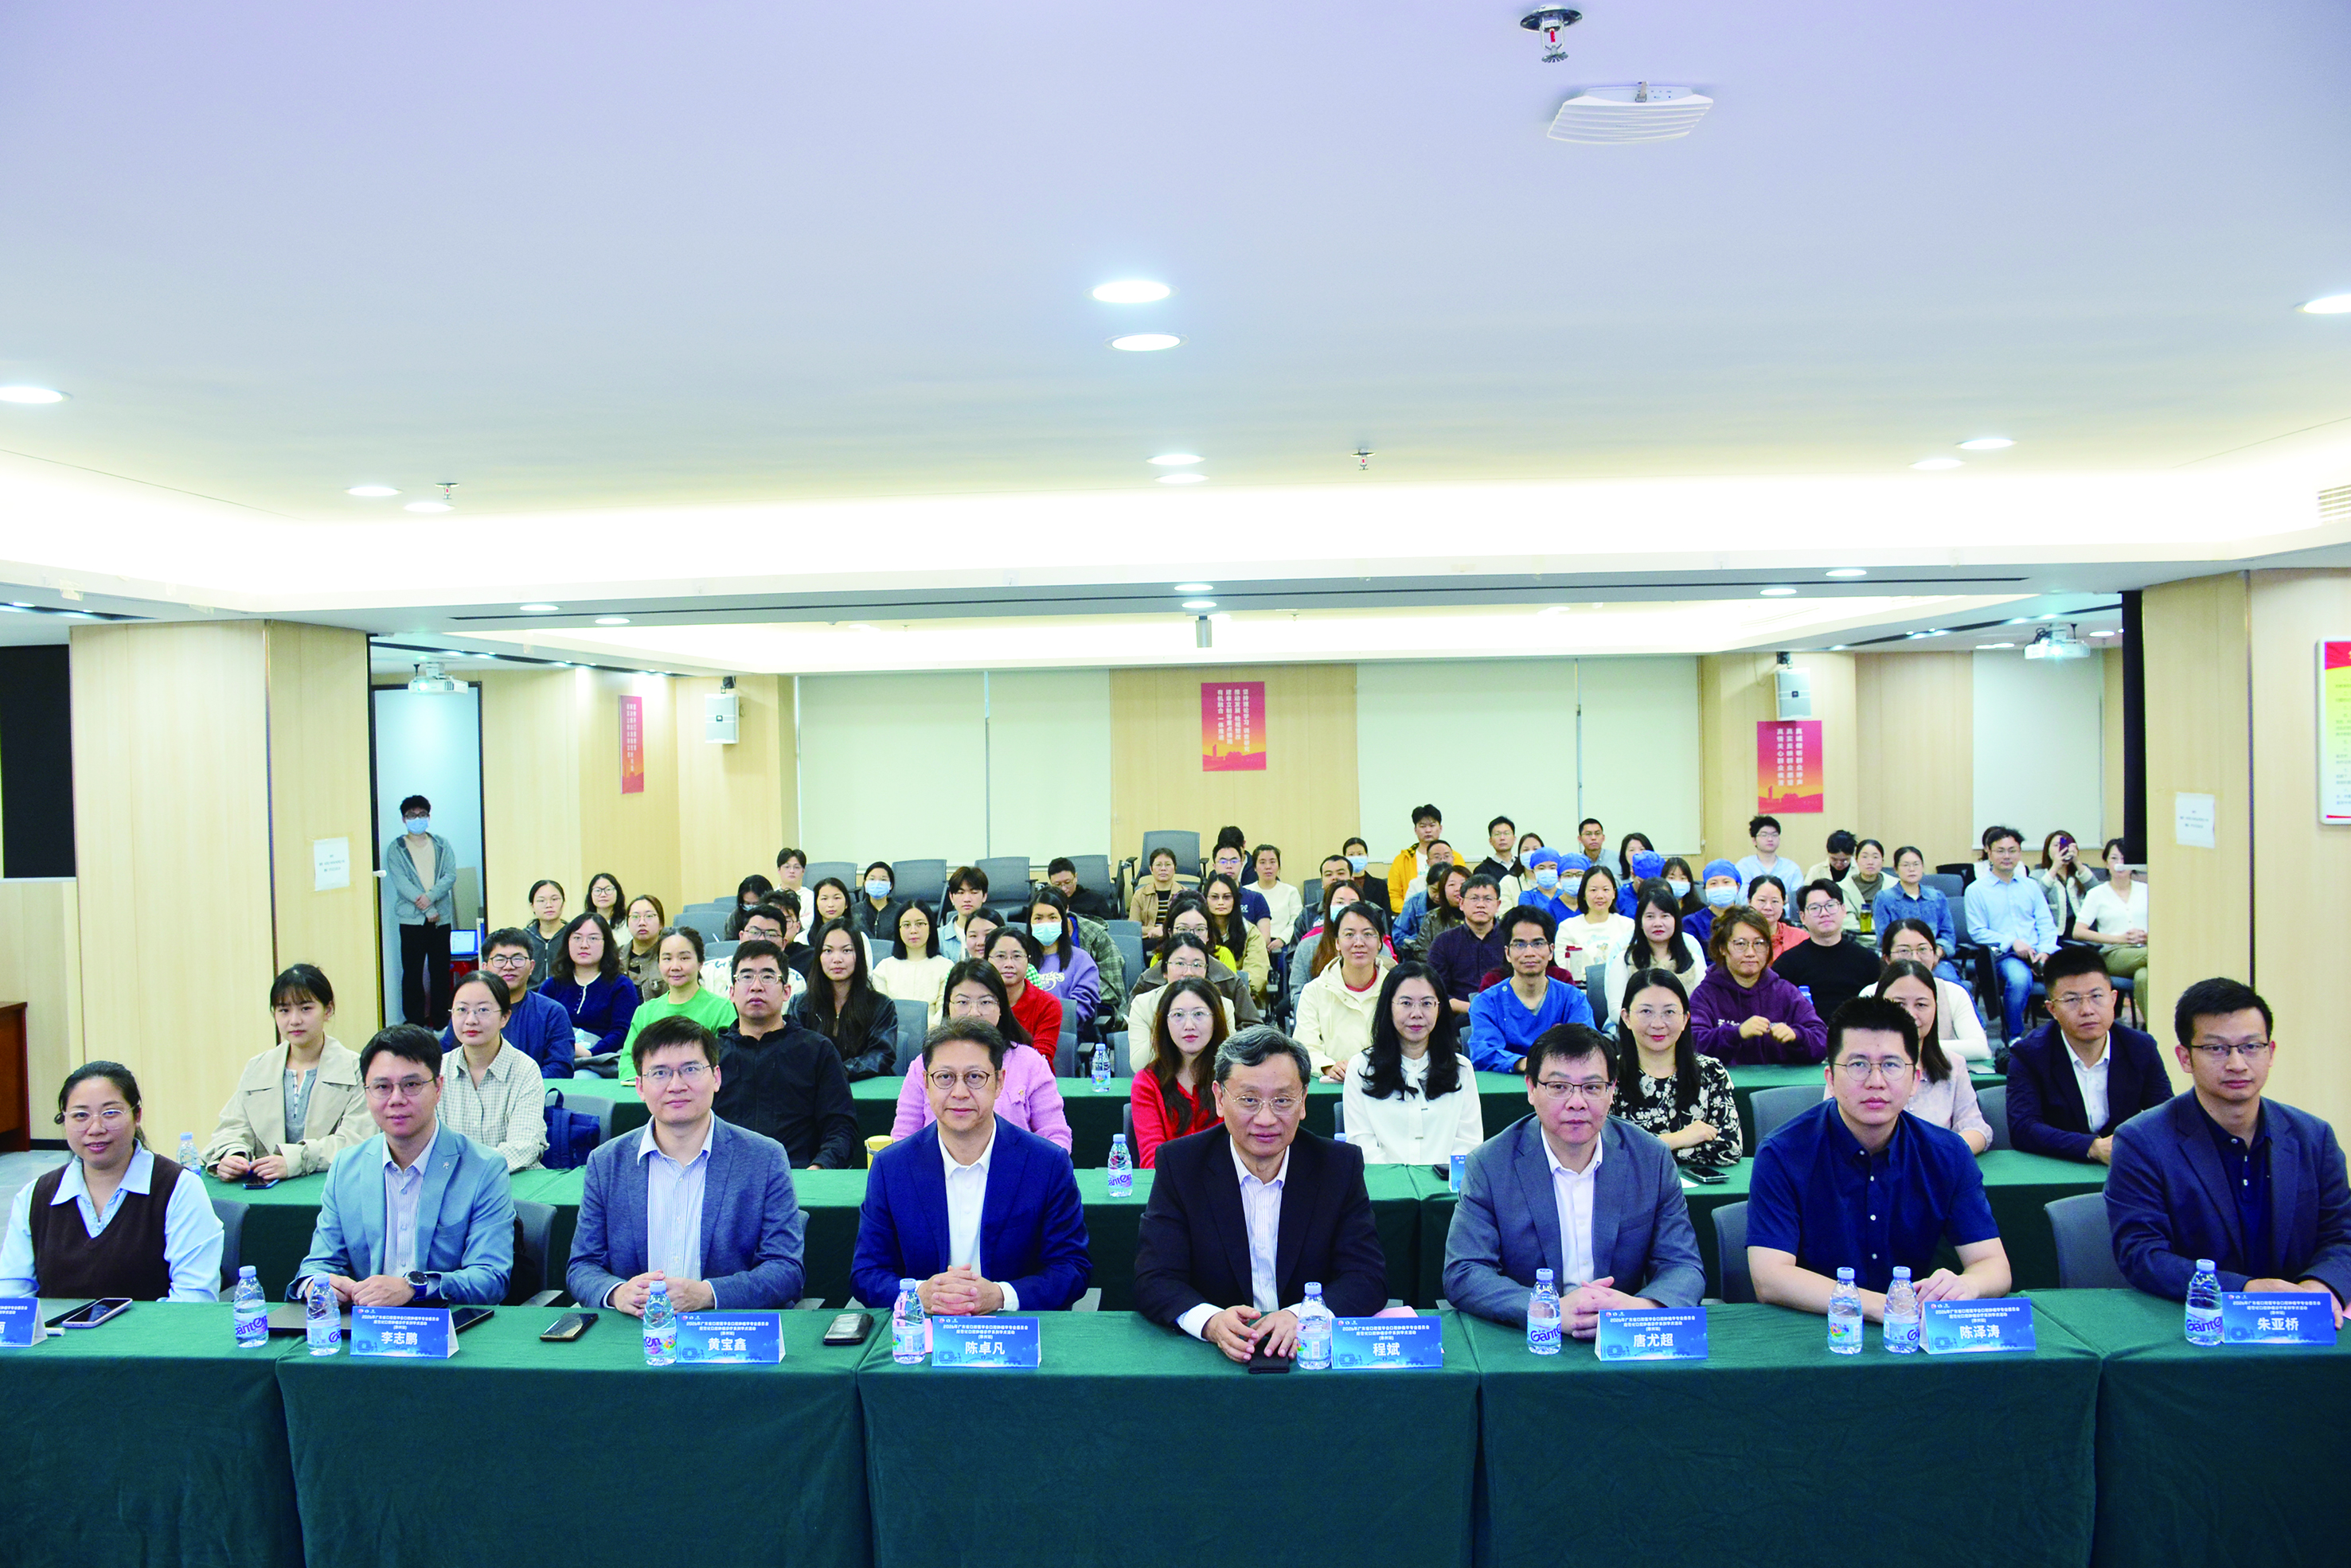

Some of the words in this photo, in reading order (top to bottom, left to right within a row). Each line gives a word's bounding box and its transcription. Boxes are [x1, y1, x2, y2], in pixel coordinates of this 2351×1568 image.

[2257, 1317, 2299, 1331] 朱亚桥
[381, 1331, 418, 1345] 李志鹏
[1959, 1324, 2000, 1339] 陈泽涛
[708, 1337, 747, 1351] 黄宝鑫
[1634, 1332, 1673, 1347] 唐尤超
[965, 1341, 1006, 1355] 陈卓凡
[1373, 1342, 1400, 1356] 程斌
